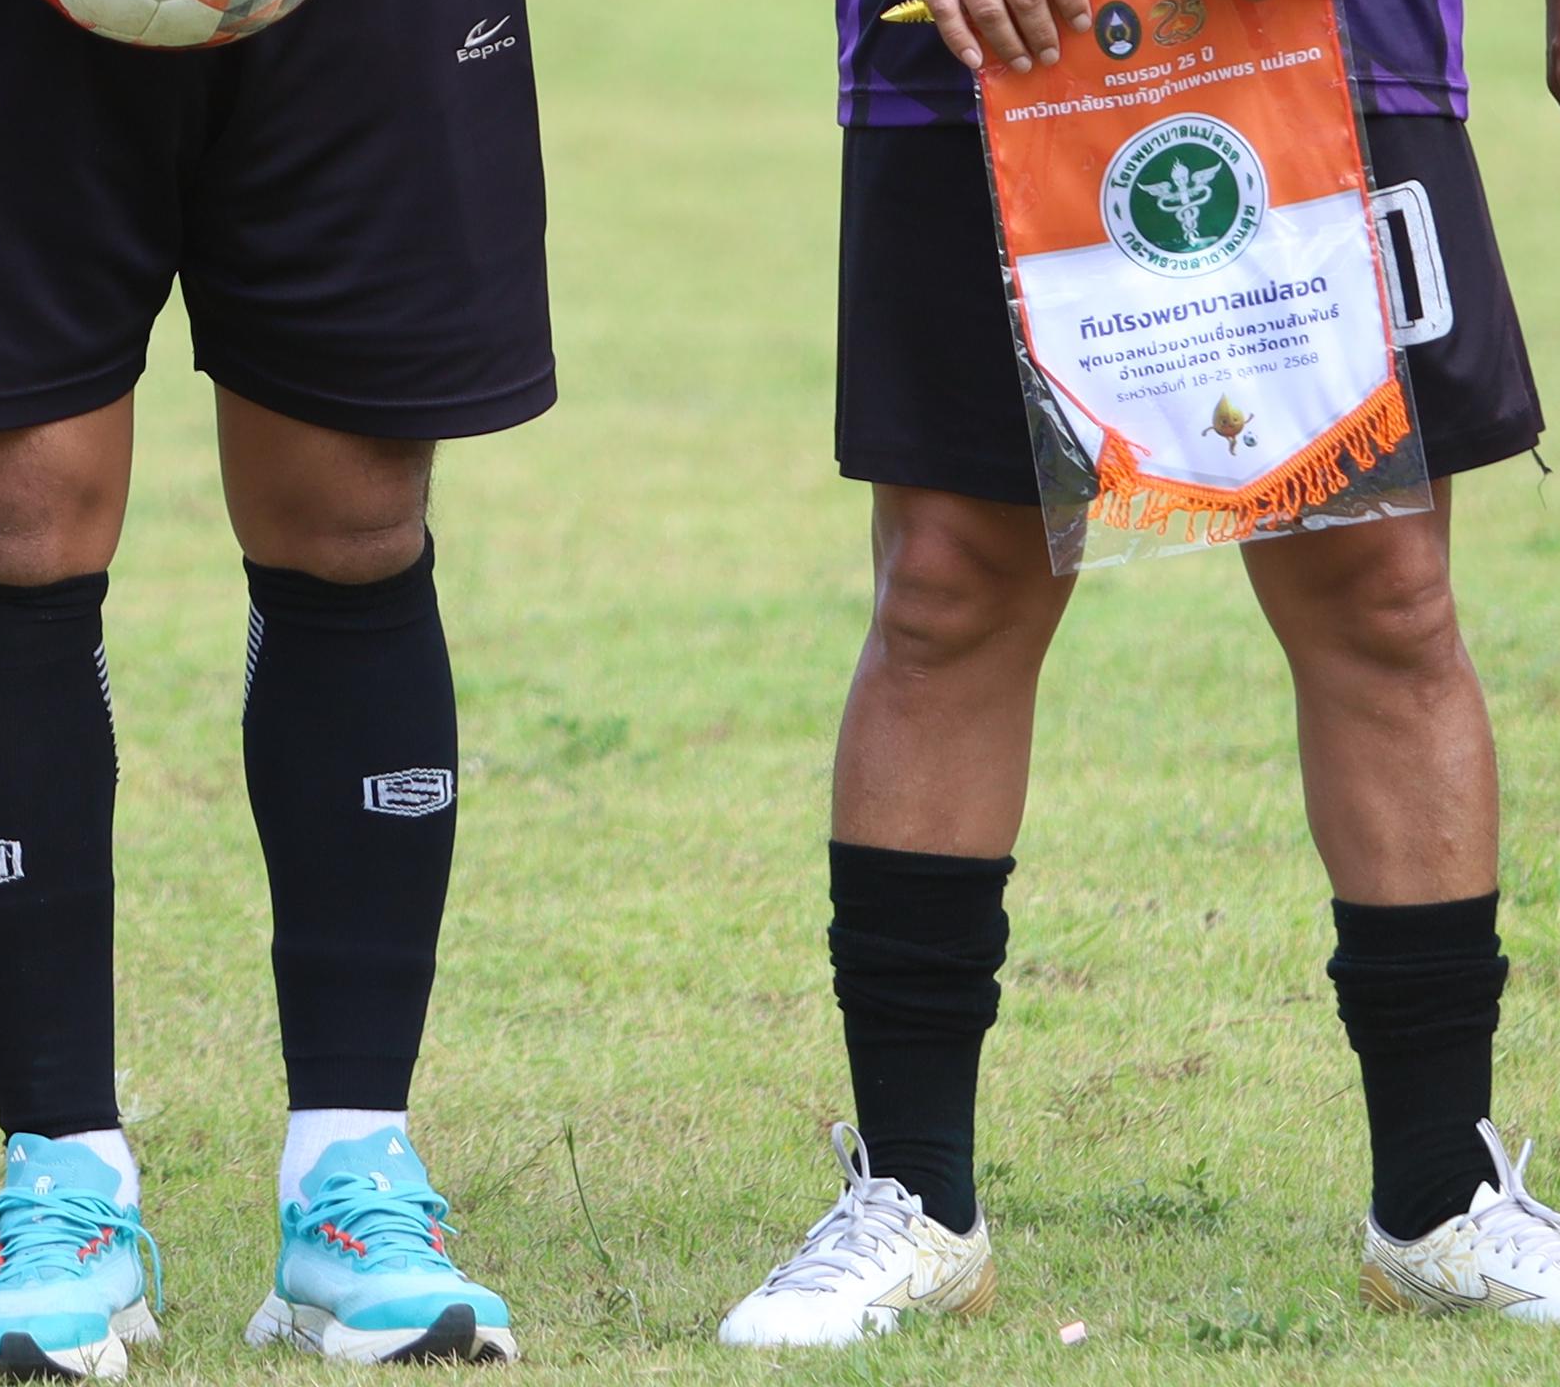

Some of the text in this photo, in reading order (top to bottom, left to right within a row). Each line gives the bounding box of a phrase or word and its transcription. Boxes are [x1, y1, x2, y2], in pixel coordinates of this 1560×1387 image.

[456, 36, 516, 63] Eepro
[1104, 45, 1215, 88] ครบรอบ 25 ปี
[1004, 45, 1323, 123] มหาวิทยาลัยราชภัฏกำแพงเพชร แม่สอด
[1111, 125, 1241, 189] โรงพยาบาลแม่สอด
[1122, 204, 1259, 271] กระทรวงสาธารณสุข
[1079, 275, 1328, 340] ทีมโรงพยาบาลแม่สอด
[1117, 377, 1187, 402] ระหว่างวันที่
[1192, 370, 1233, 388] 18-25
[1284, 352, 1320, 369] 2568
[1119, 333, 1310, 381] อำเภอแม่สอด จังหวัดตาก
